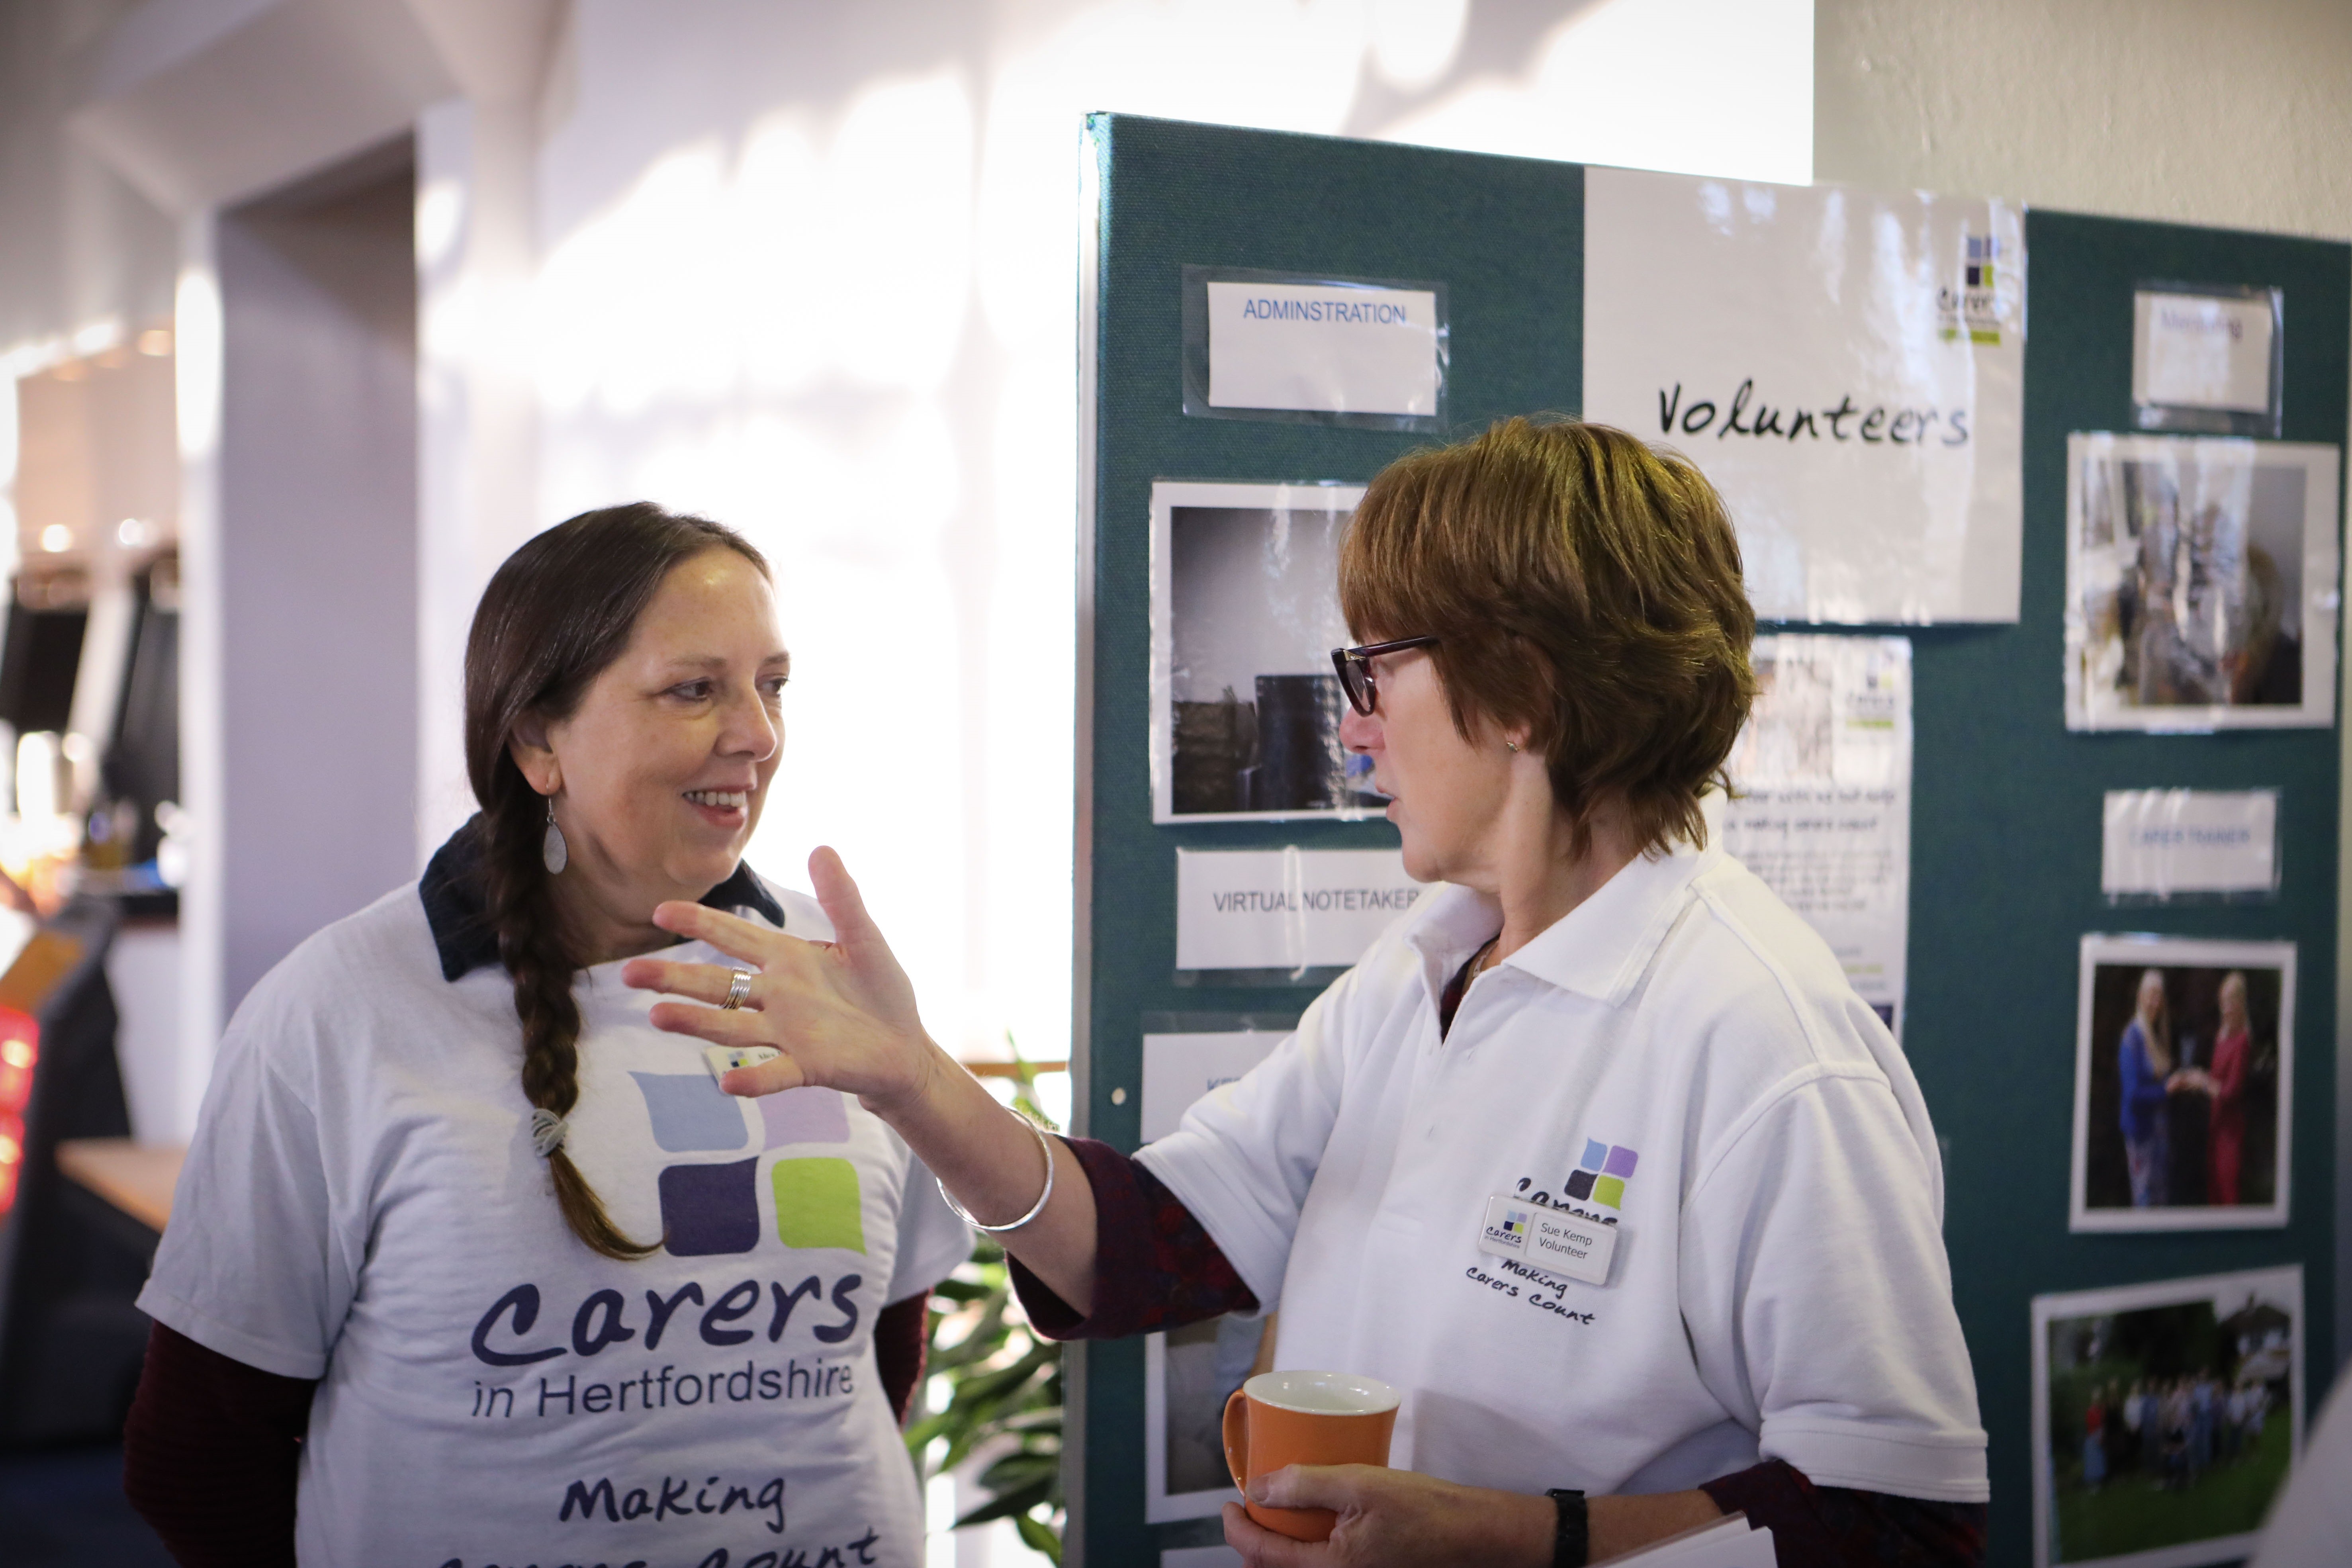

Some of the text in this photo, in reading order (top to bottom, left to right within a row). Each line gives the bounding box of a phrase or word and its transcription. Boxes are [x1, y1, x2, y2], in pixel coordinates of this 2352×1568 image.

[1243, 299, 1406, 323] ADMINSTRATION
[1659, 378, 1970, 445] Volunteers
[1213, 892, 1297, 912] VIRTUAL
[1486, 1226, 1522, 1243] Carers
[1539, 1237, 1588, 1259] Volunteer
[1541, 1223, 1593, 1246] Sue Kemp
[1466, 1267, 1595, 1325] Carers Count
[1501, 1259, 1568, 1299] Making
[471, 1274, 862, 1366] Carers
[471, 1359, 853, 1418] in Hertfordshire
[559, 1476, 785, 1533] Making
